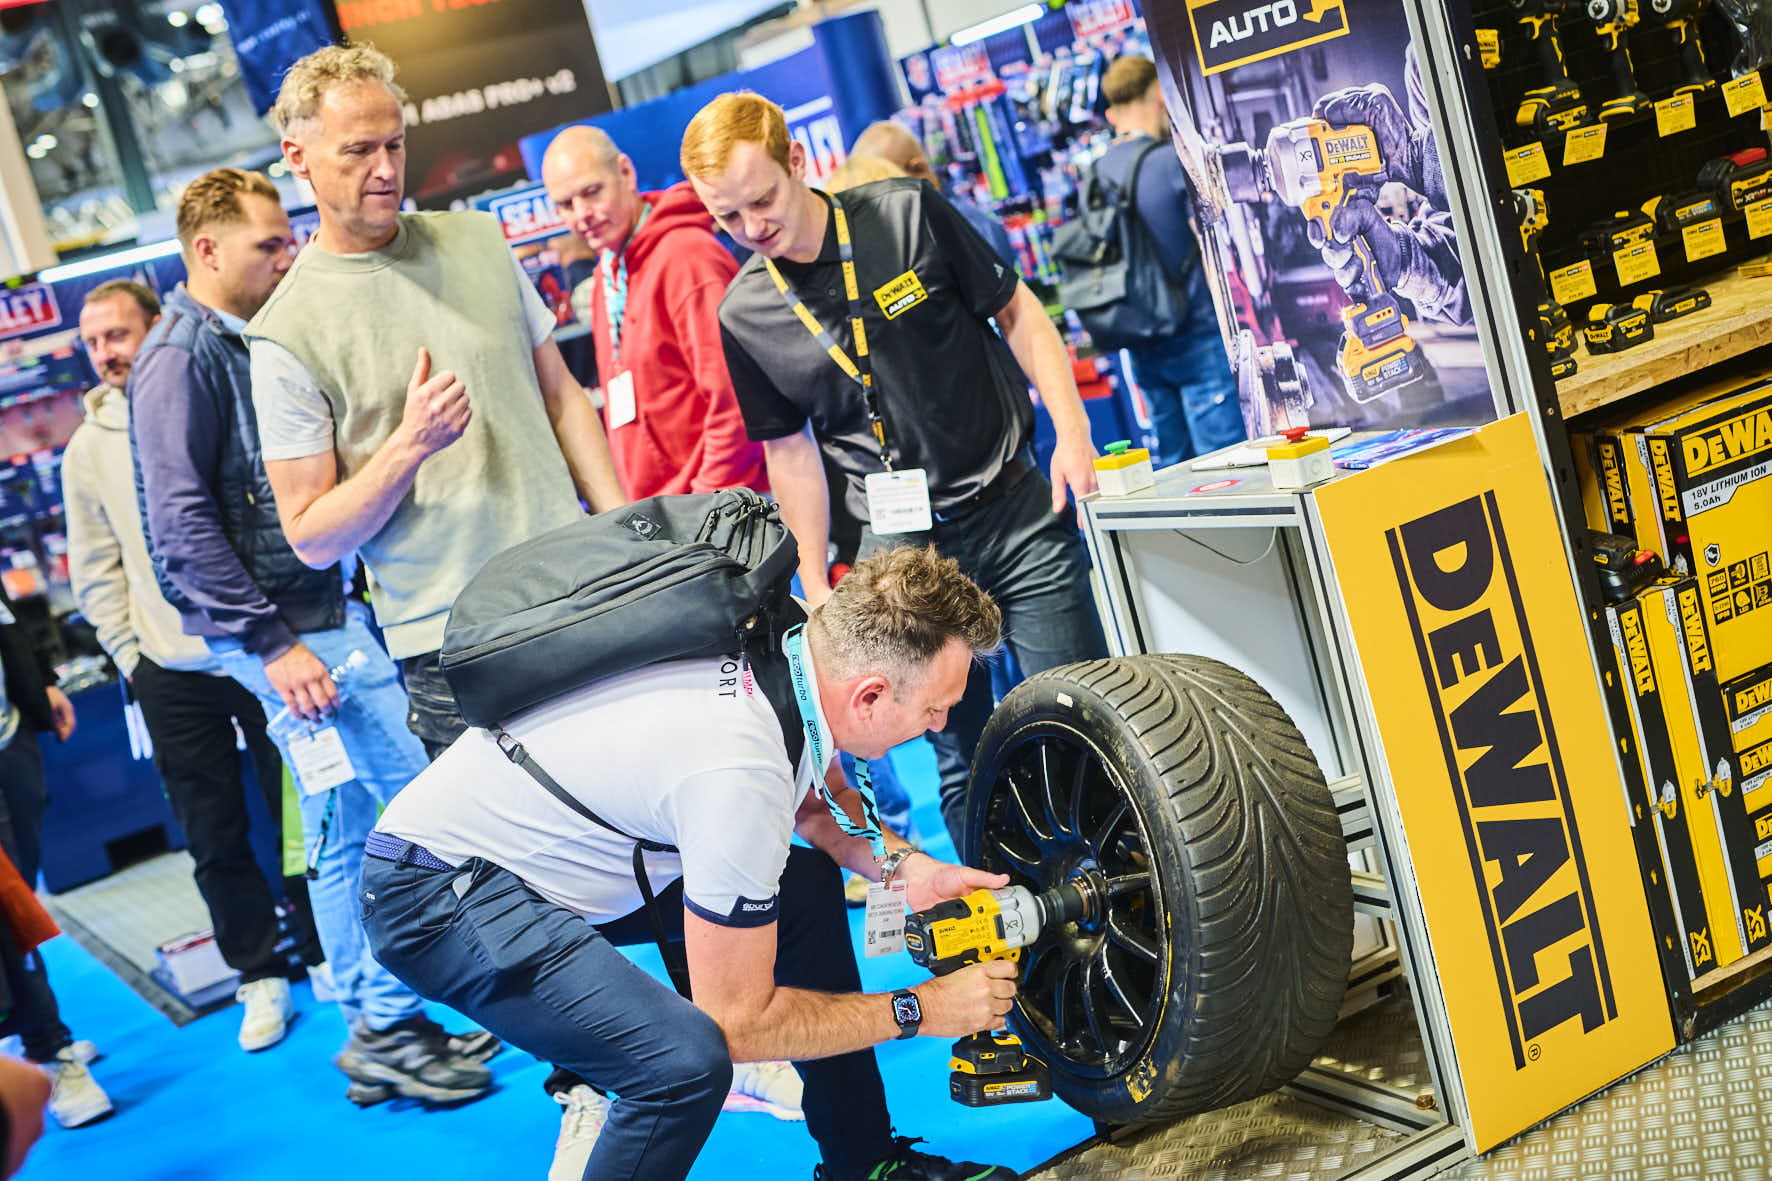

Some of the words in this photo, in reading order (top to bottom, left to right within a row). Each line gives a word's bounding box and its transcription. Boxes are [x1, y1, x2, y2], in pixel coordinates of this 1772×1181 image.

[1210, 0, 1297, 48] AUTO
[1300, 150, 1313, 162] XR
[1325, 136, 1368, 155] DEWALT
[881, 278, 913, 302] DEWALT
[1601, 443, 1628, 524] DEWALT
[1649, 440, 1681, 522] DEWALT
[1692, 486, 1708, 500] 18V
[1711, 472, 1748, 493] LITHIUM
[1751, 465, 1767, 477] ION
[1694, 496, 1721, 510] 5.0Ah
[1679, 587, 1711, 676] DEWALT
[1620, 608, 1655, 697] DEWALT
[1400, 495, 1605, 1042] DEWALT
[1006, 920, 1019, 929] XR
